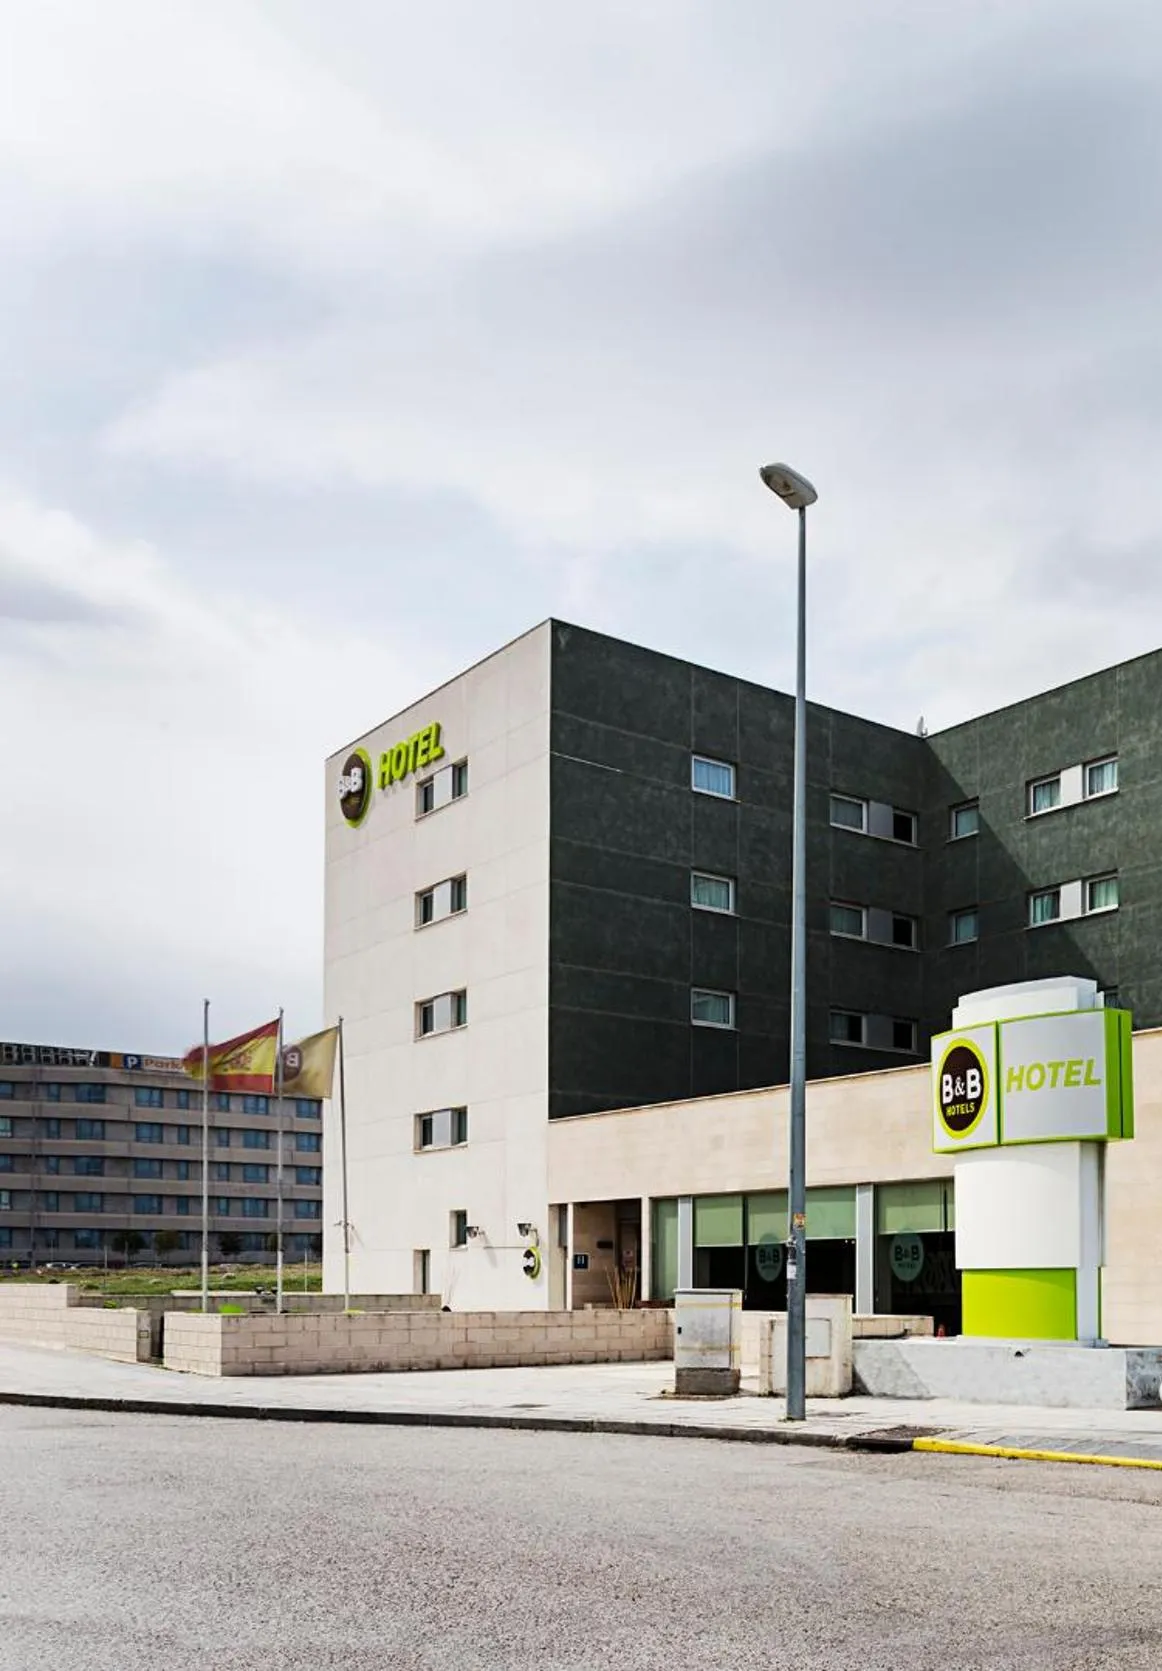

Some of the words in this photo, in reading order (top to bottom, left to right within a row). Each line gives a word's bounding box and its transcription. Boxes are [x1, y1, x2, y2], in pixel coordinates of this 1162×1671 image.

[376, 721, 445, 790] HOTEL
[942, 1068, 982, 1104] B&B
[1006, 1057, 1102, 1093] HOTEL
[946, 1102, 975, 1116] HOTELS
